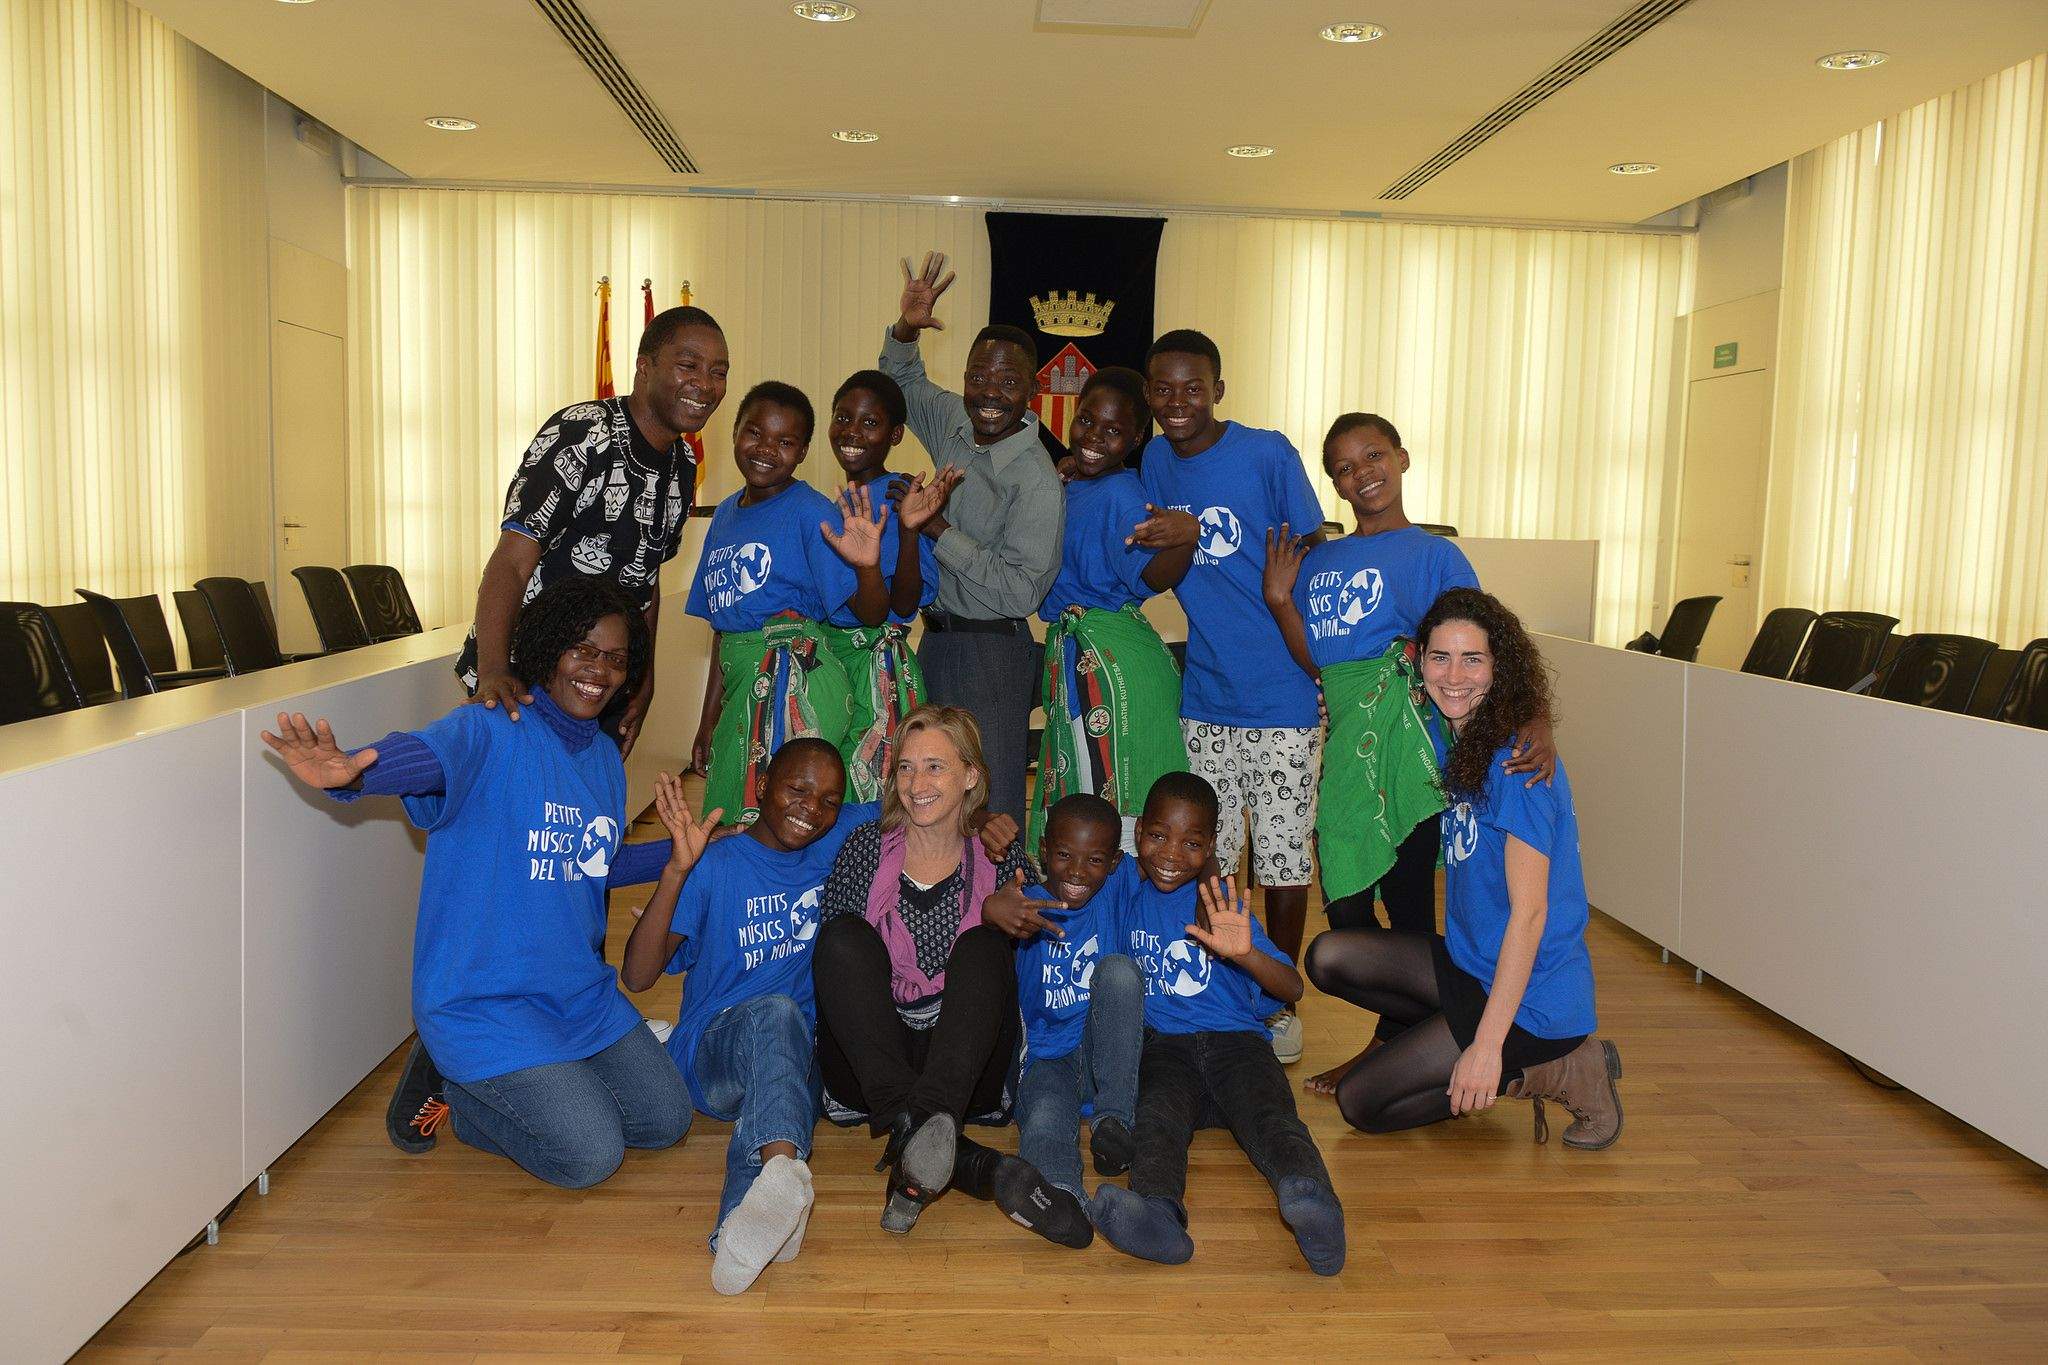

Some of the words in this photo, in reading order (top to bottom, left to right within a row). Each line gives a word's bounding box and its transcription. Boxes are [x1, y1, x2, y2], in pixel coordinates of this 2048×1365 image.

[708, 544, 736, 567] PETITS
[1309, 570, 1343, 591] PETITS
[545, 801, 583, 828] PETITS
[527, 826, 575, 854] MÚSICS
[530, 858, 556, 881] DEL
[746, 893, 788, 919] PETITS
[738, 920, 785, 948] MÚSICS
[1130, 929, 1162, 955] PETITS
[770, 938, 793, 961] MÓN
[1046, 940, 1072, 959] TITS
